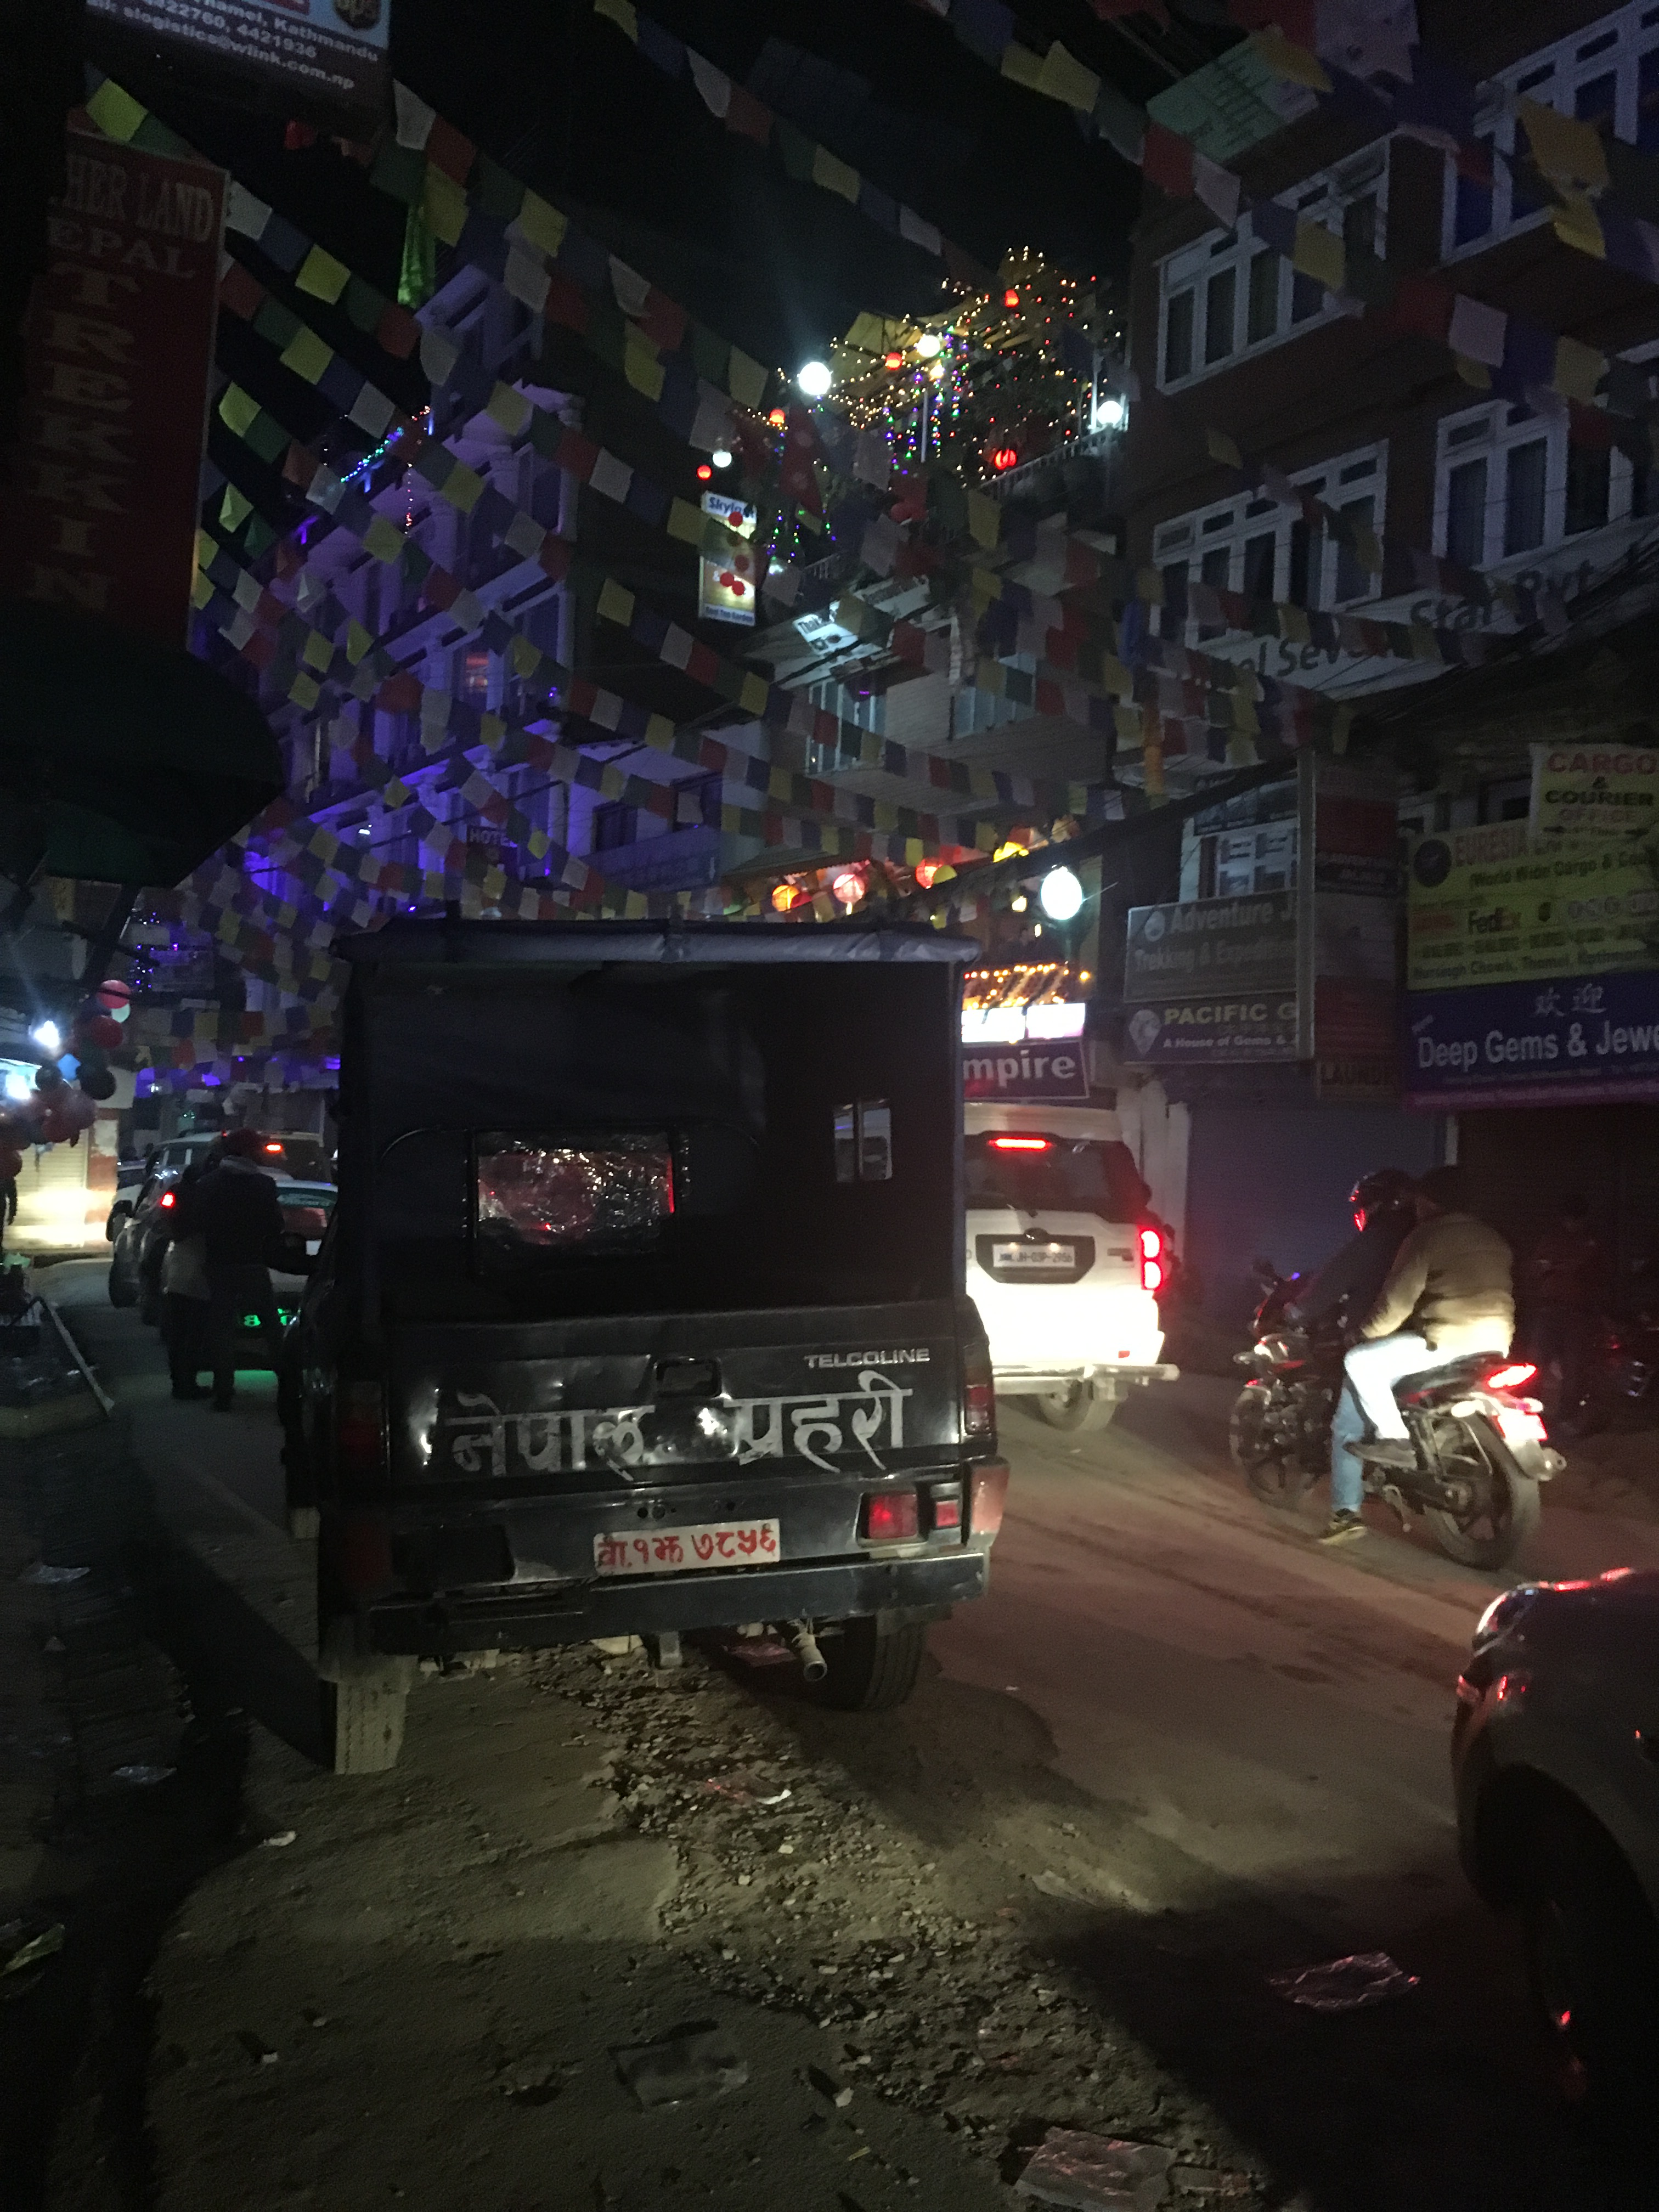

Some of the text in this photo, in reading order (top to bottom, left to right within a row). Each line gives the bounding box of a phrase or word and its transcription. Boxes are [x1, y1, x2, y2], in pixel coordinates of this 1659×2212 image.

[195, 0, 379, 61] hamel, Kathmandu
[50, 153, 212, 244] HER LAND
[1547, 751, 1658, 775] CARGO
[1544, 789, 1654, 806] COURIER
[1169, 902, 1274, 933] Adventure
[1163, 1003, 1268, 1026] PACIFIC
[1173, 1037, 1215, 1048] House
[1216, 1035, 1231, 1047] of
[1418, 1036, 1479, 1073] Deep
[1485, 1029, 1559, 1064] Gems
[1567, 1022, 1588, 1058] &
[804, 1347, 930, 1370] TELCOLINE
[445, 1370, 914, 1482] नेपाल प्रहरी
[691, 1523, 776, 1560] ७८५६
